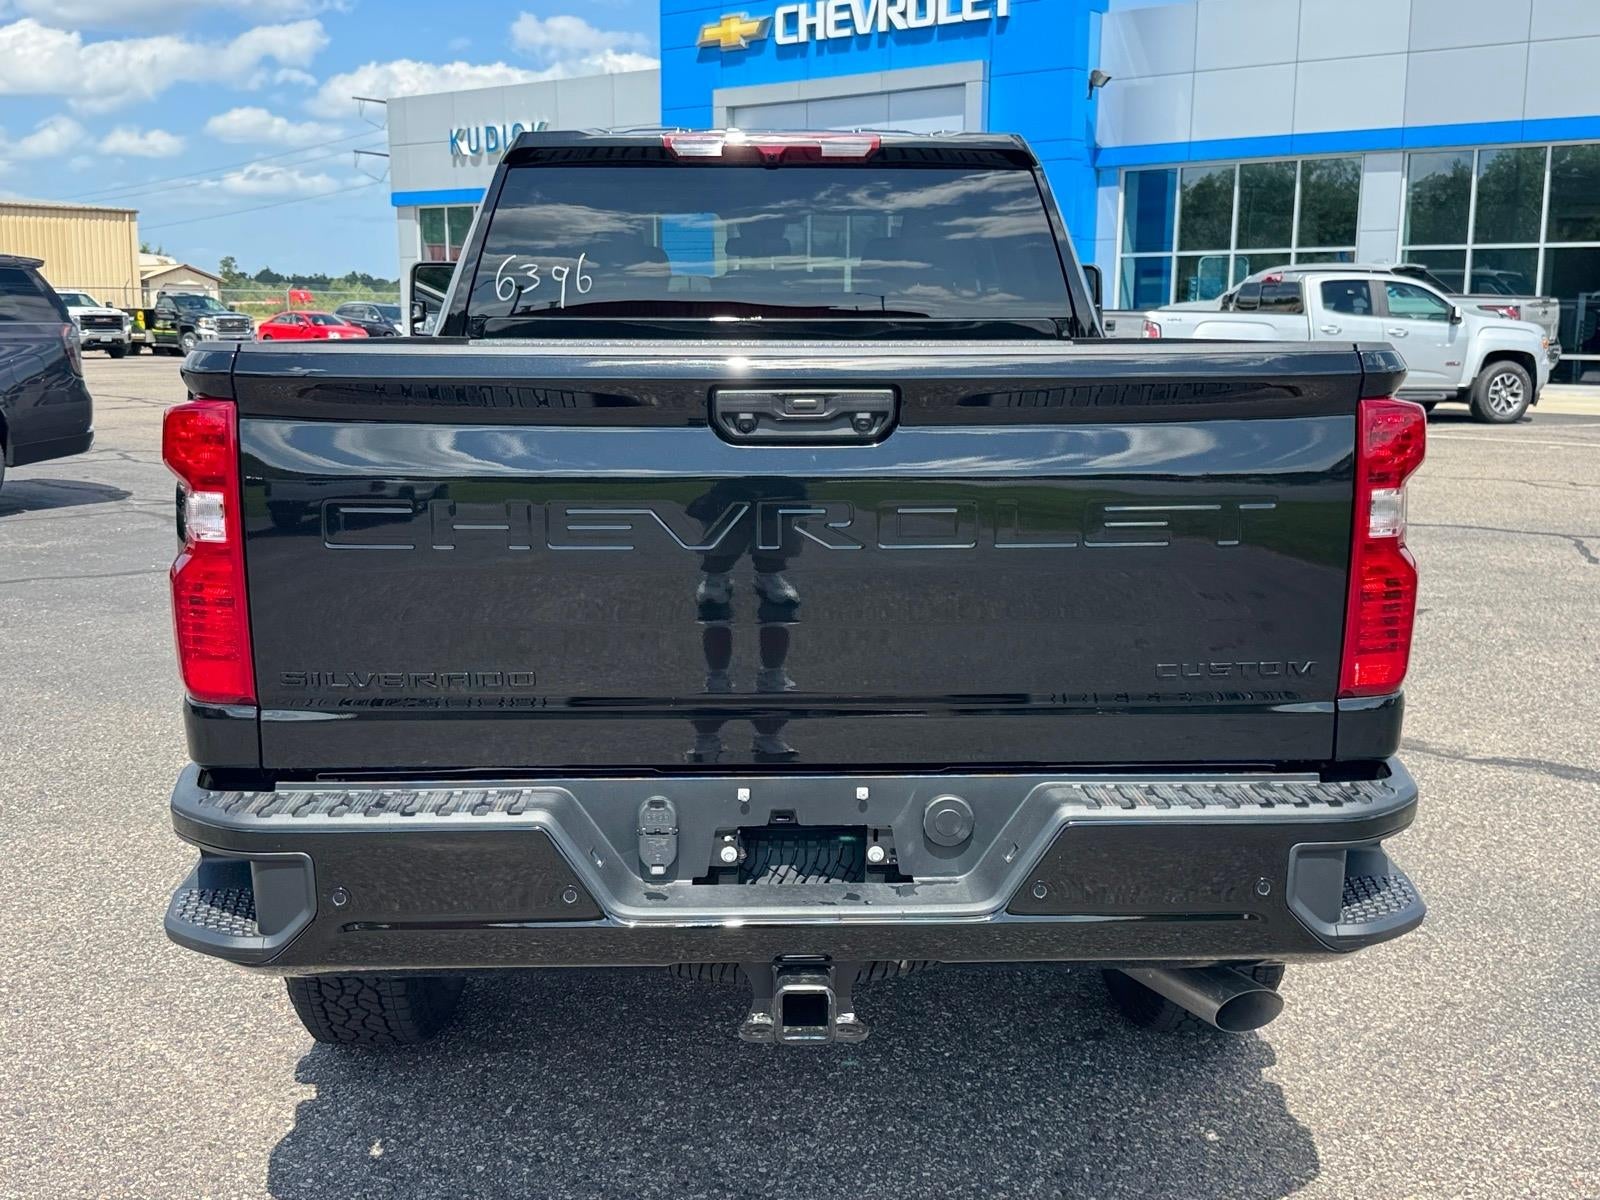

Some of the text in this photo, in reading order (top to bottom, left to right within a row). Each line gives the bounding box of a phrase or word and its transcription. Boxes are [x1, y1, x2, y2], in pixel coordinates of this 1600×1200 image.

[495, 252, 593, 309] 6396
[321, 495, 1278, 551] CHEVROLET
[280, 670, 537, 688] SILVERADO
[1155, 661, 1318, 680] CUSTOM
